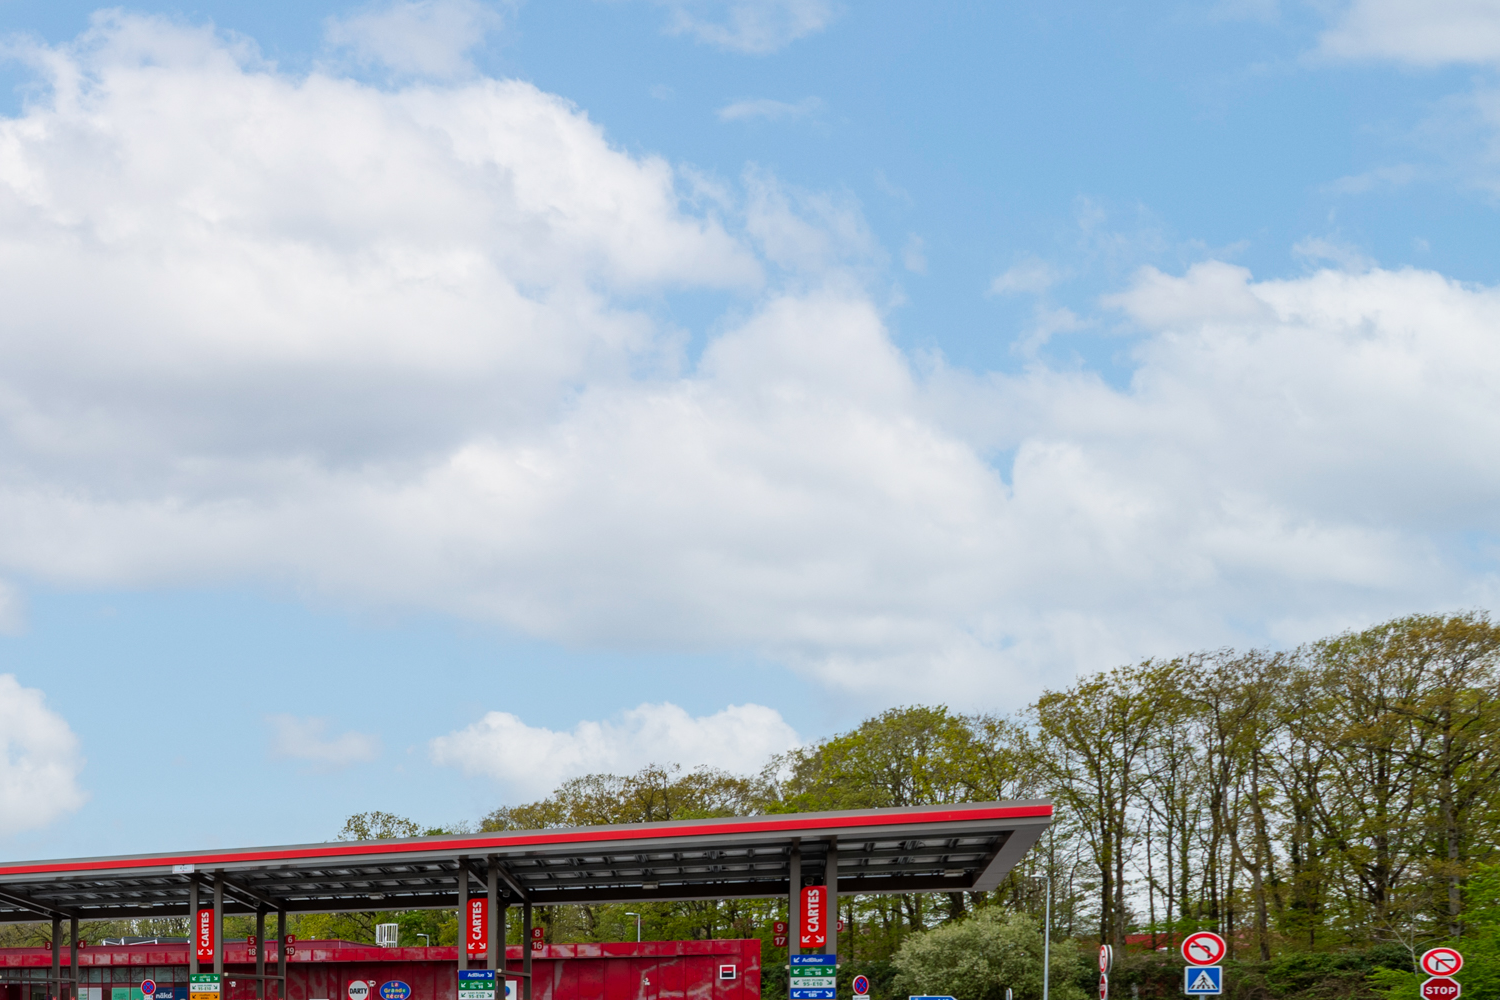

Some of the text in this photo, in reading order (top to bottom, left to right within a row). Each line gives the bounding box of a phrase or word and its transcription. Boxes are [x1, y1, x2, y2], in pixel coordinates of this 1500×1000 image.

[807, 889, 819, 933] CARTES
[472, 901, 482, 940] CARTES
[201, 911, 210, 947] CARTES
[776, 923, 784, 932] 9
[534, 929, 540, 937] 8
[287, 936, 293, 944] 6
[774, 937, 786, 945] 17
[532, 941, 542, 949] 16
[248, 948, 256, 956] 18
[286, 947, 295, 955] 19
[1425, 986, 1457, 995] STOP
